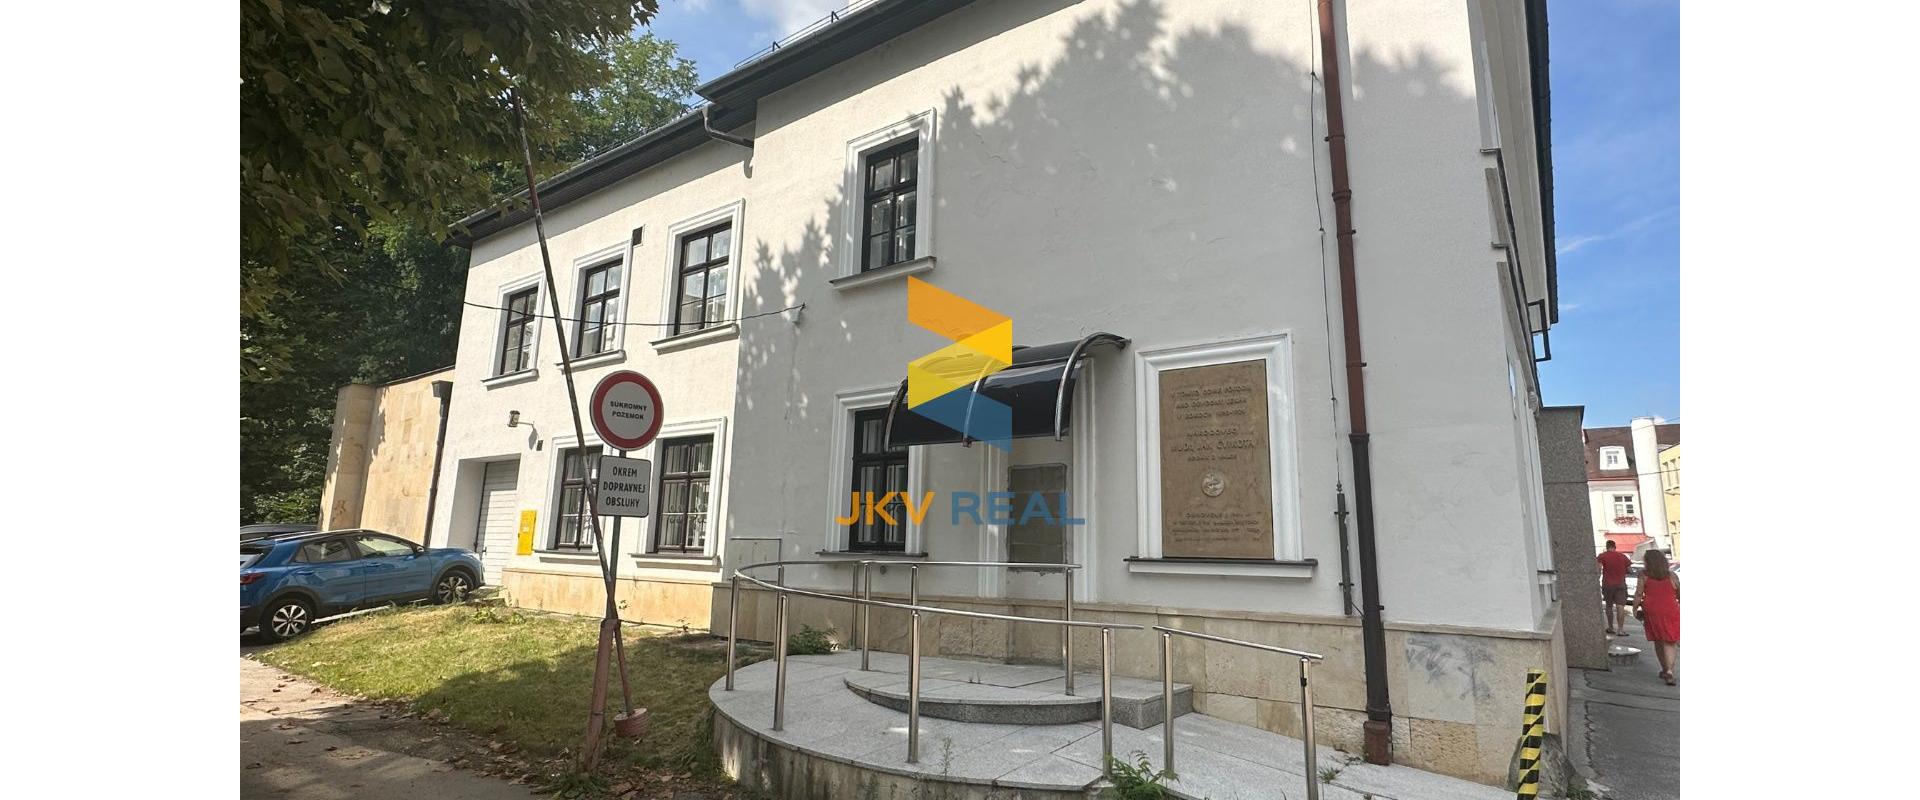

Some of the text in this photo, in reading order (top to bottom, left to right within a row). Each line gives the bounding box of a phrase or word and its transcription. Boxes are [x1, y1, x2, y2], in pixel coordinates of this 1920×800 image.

[612, 411, 644, 420] POZEMOK
[612, 466, 638, 478] OKREM
[603, 481, 646, 494] DOPRAVNEJ
[605, 496, 640, 508] OBSLUHY
